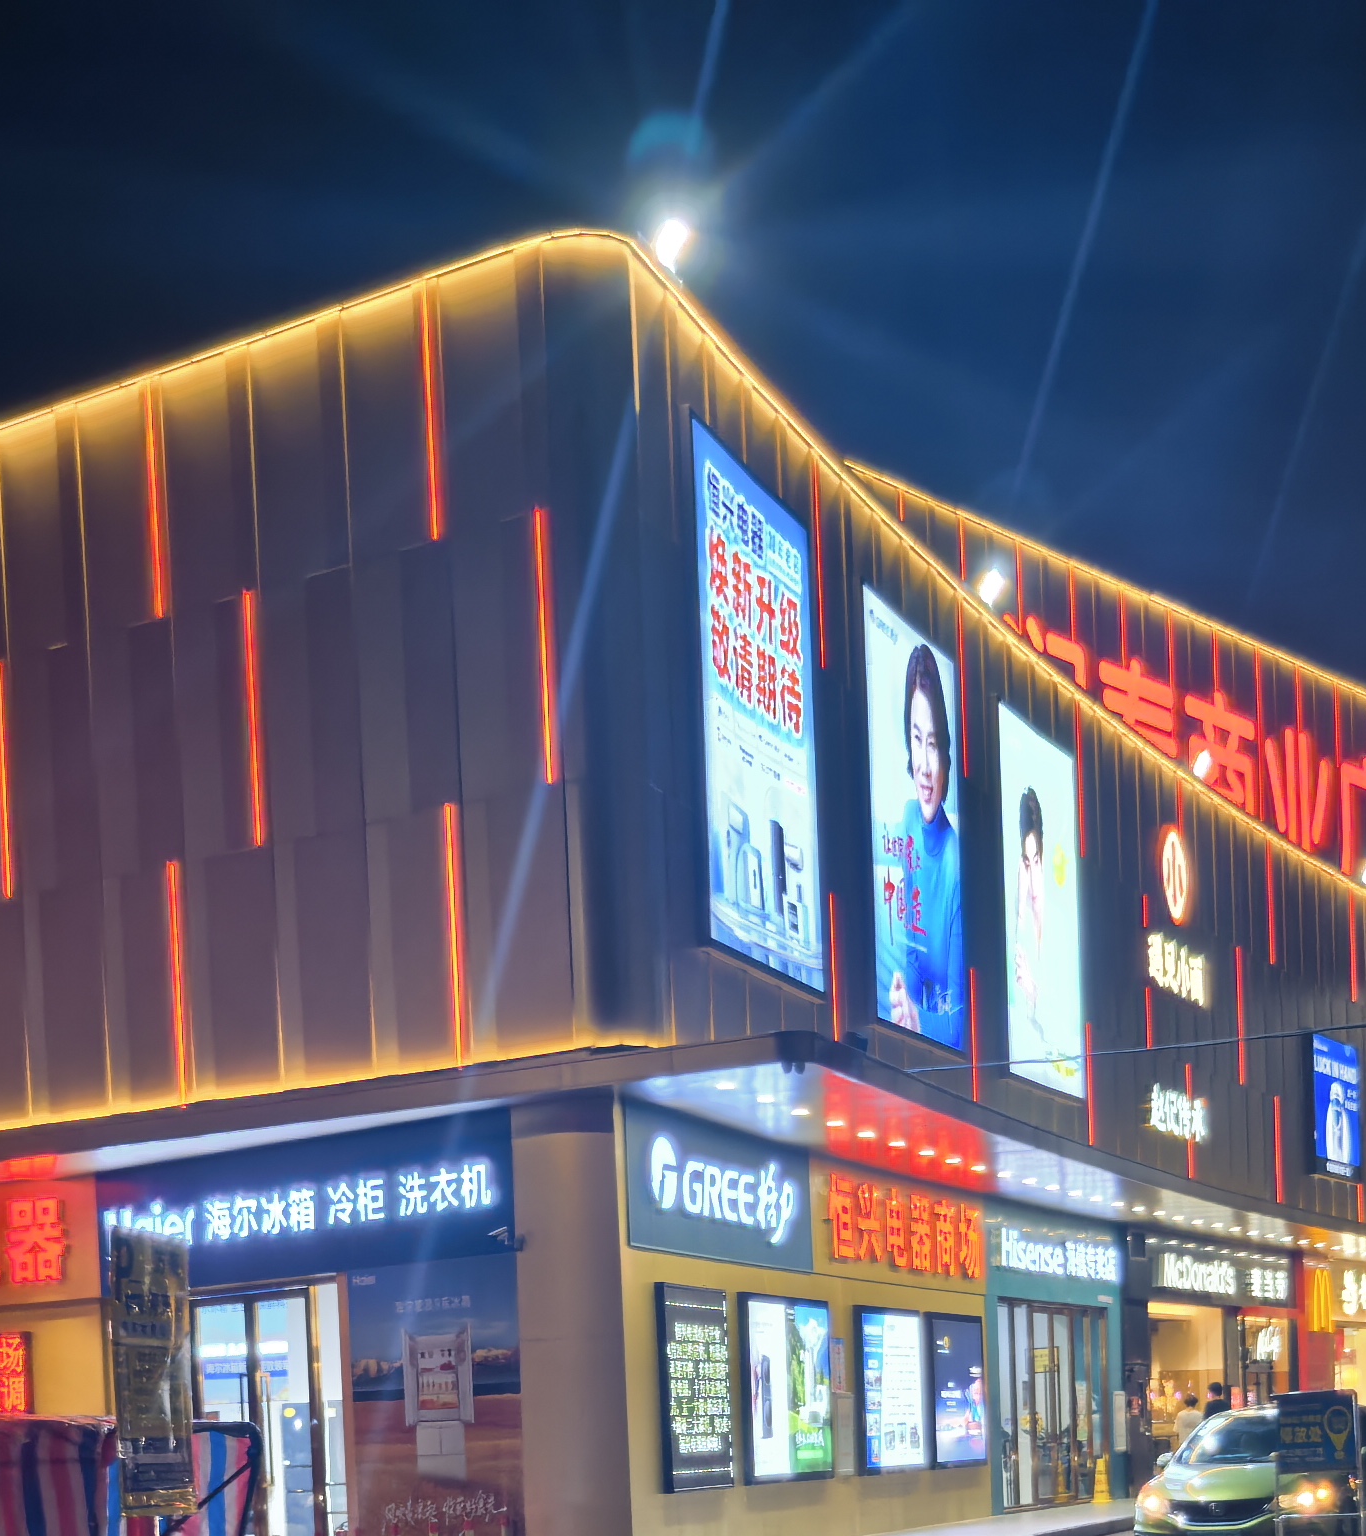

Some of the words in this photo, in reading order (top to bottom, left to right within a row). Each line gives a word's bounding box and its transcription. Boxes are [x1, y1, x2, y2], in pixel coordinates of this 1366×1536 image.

[711, 604, 803, 737] 敬请期待
[206, 1187, 316, 1241] 海尔冰箱
[327, 1179, 386, 1227] 冷柜
[398, 1163, 493, 1218] 洗衣机
[682, 1161, 755, 1226] GREE
[756, 1161, 795, 1245] 格力
[827, 1172, 982, 1279] 恒兴电器商场
[1001, 1227, 1065, 1275] Hisense
[1163, 1252, 1237, 1295] McDonald's
